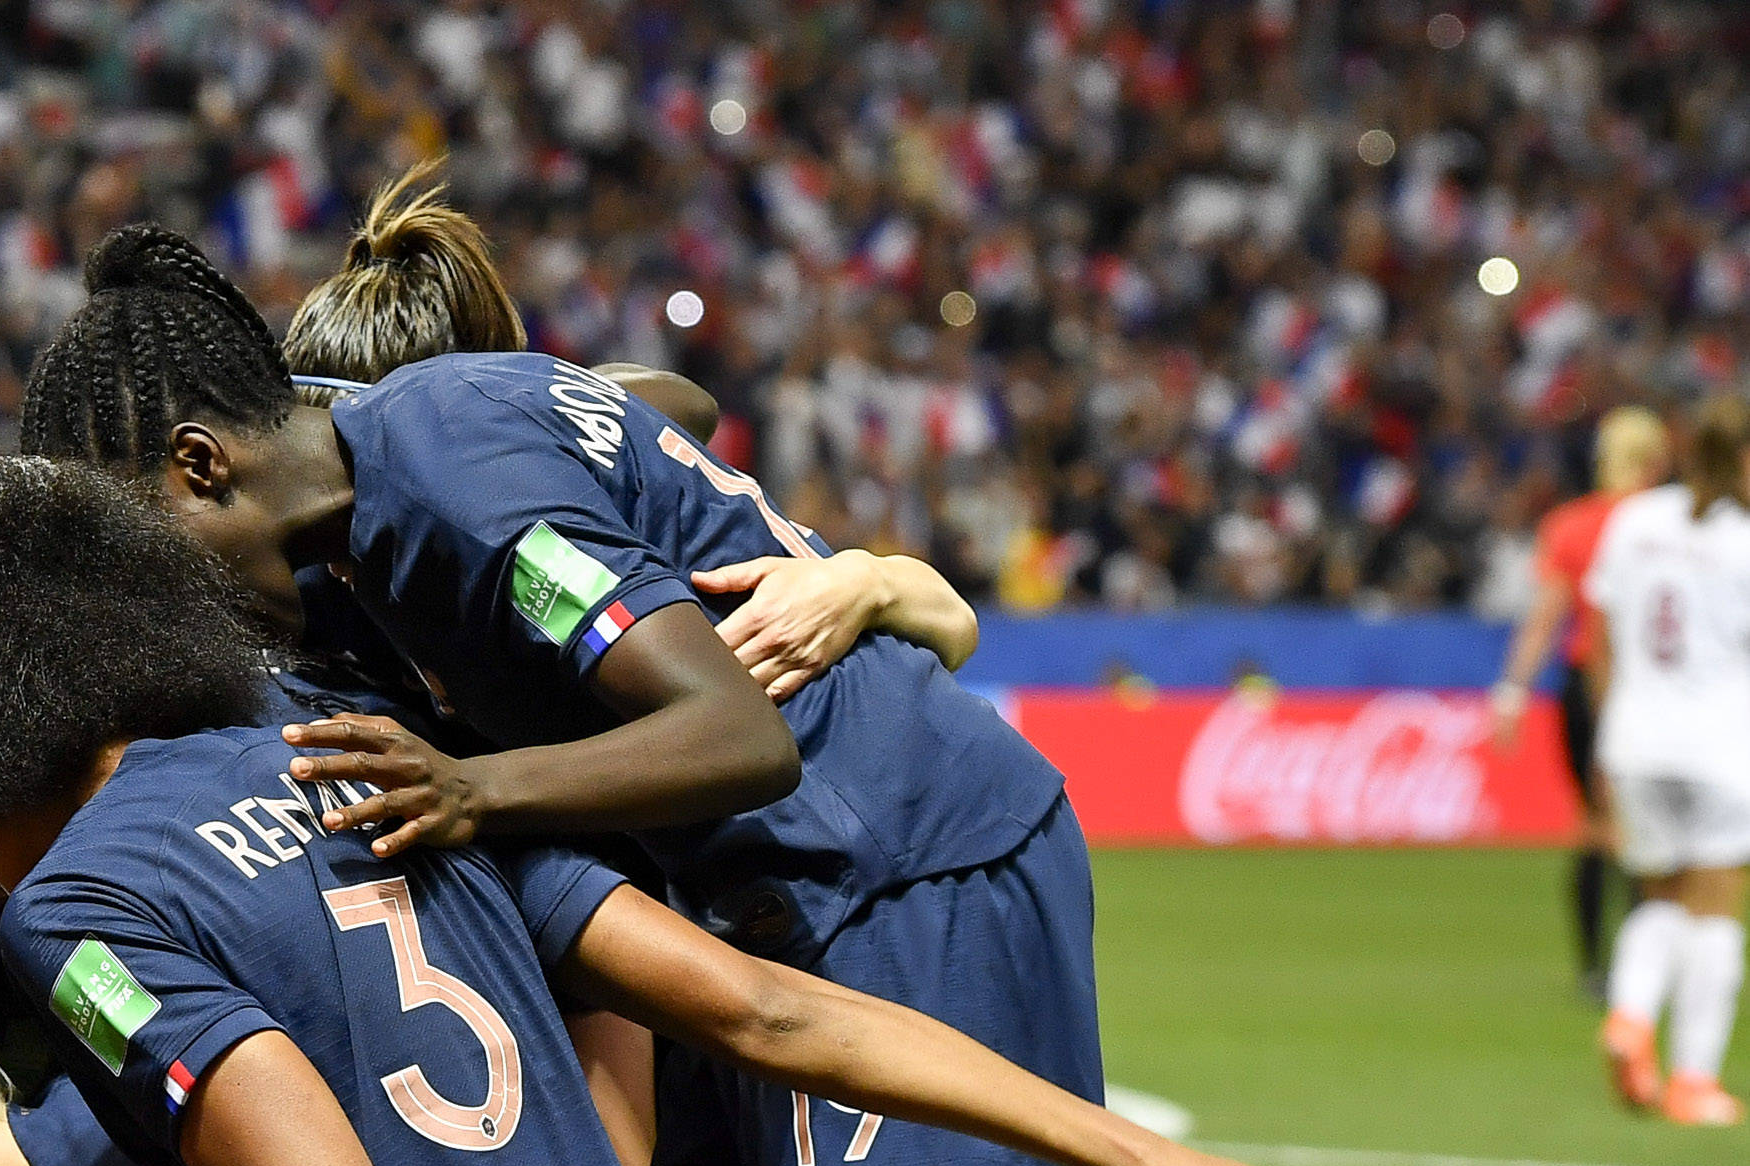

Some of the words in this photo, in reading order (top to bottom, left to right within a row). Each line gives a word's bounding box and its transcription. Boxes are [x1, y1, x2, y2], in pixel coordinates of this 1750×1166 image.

[1178, 688, 1496, 842] Coca-Cola
[71, 959, 111, 1027] LIVING
[77, 970, 119, 1034] FOOTBALL
[103, 983, 136, 1017] FIFA
[321, 874, 523, 1151] 3
